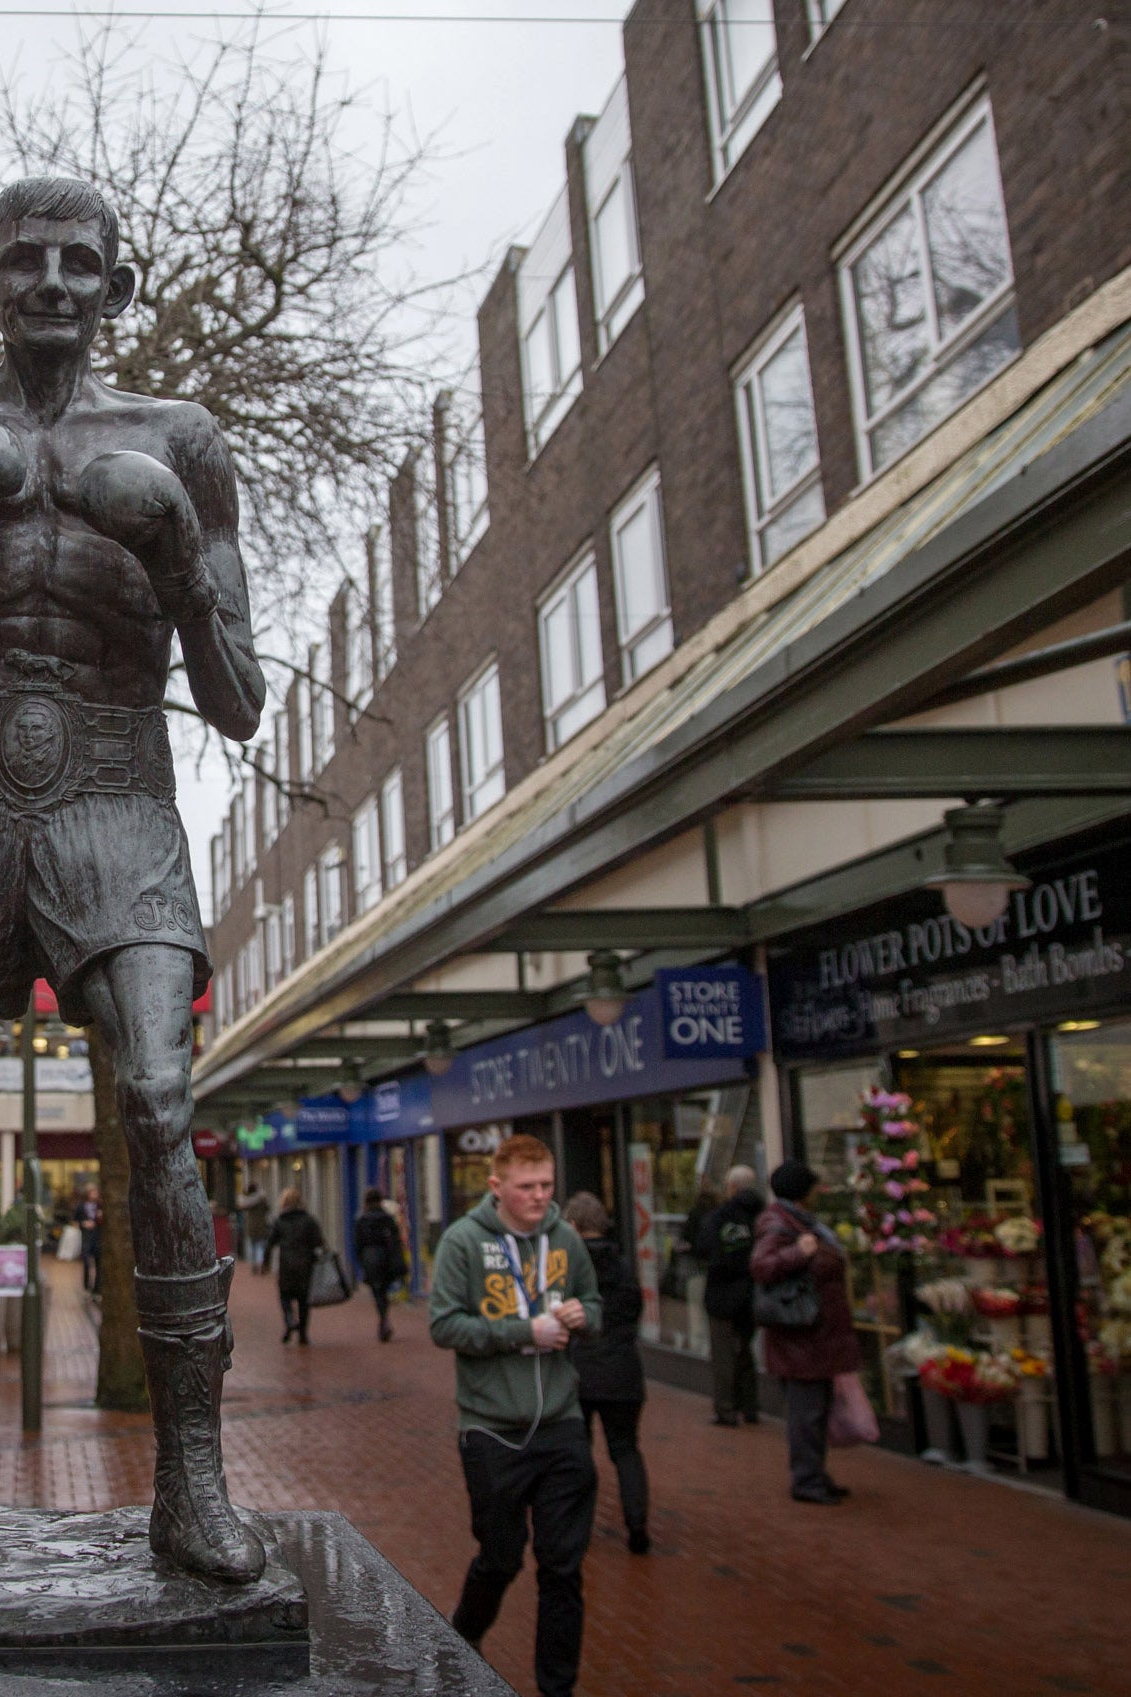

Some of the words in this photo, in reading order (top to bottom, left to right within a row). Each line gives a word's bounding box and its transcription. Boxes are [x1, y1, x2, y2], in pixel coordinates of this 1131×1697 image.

[820, 931, 907, 989] FLOWER
[908, 913, 973, 966] POTS
[1017, 869, 1102, 938] LOVE
[670, 980, 741, 1001] STORE
[902, 974, 991, 1025] Fragrances
[1001, 941, 1049, 994] Bath
[1049, 926, 1125, 985] Bombs
[670, 1017, 745, 1046] ONE
[673, 1002, 741, 1016] TWENTY
[471, 1054, 515, 1104] STORE
[517, 1031, 592, 1093] TWENTY
[600, 1016, 646, 1078] ONE
